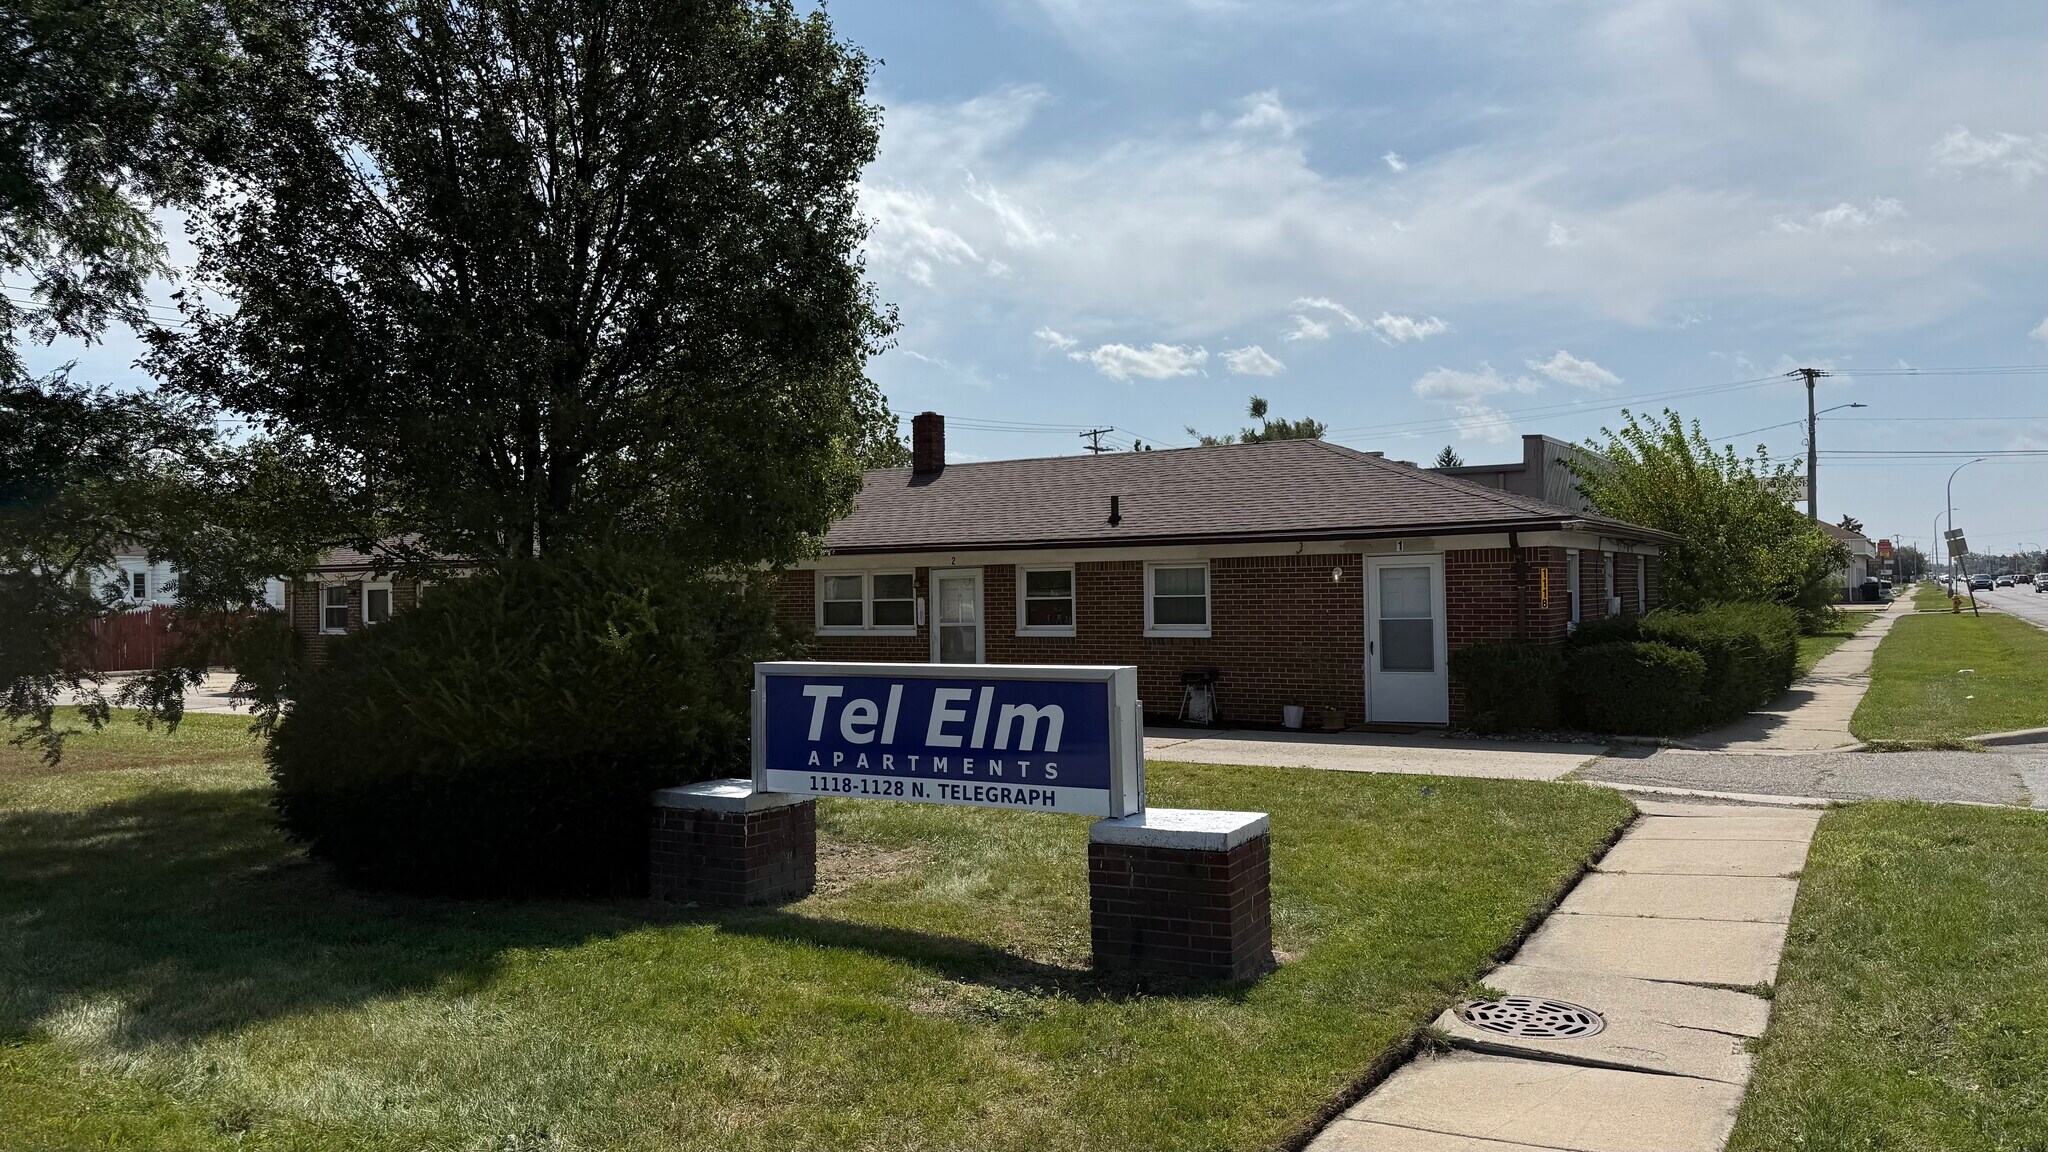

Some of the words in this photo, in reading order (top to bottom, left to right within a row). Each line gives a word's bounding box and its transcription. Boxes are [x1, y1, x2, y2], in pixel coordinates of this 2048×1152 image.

[802, 684, 904, 745] Tel
[925, 686, 1065, 753] Elm
[808, 750, 1059, 780] APARTMENTS
[809, 776, 904, 797] 1118-1128
[912, 780, 930, 799] N.
[938, 783, 1056, 807] TELEGRAPH
